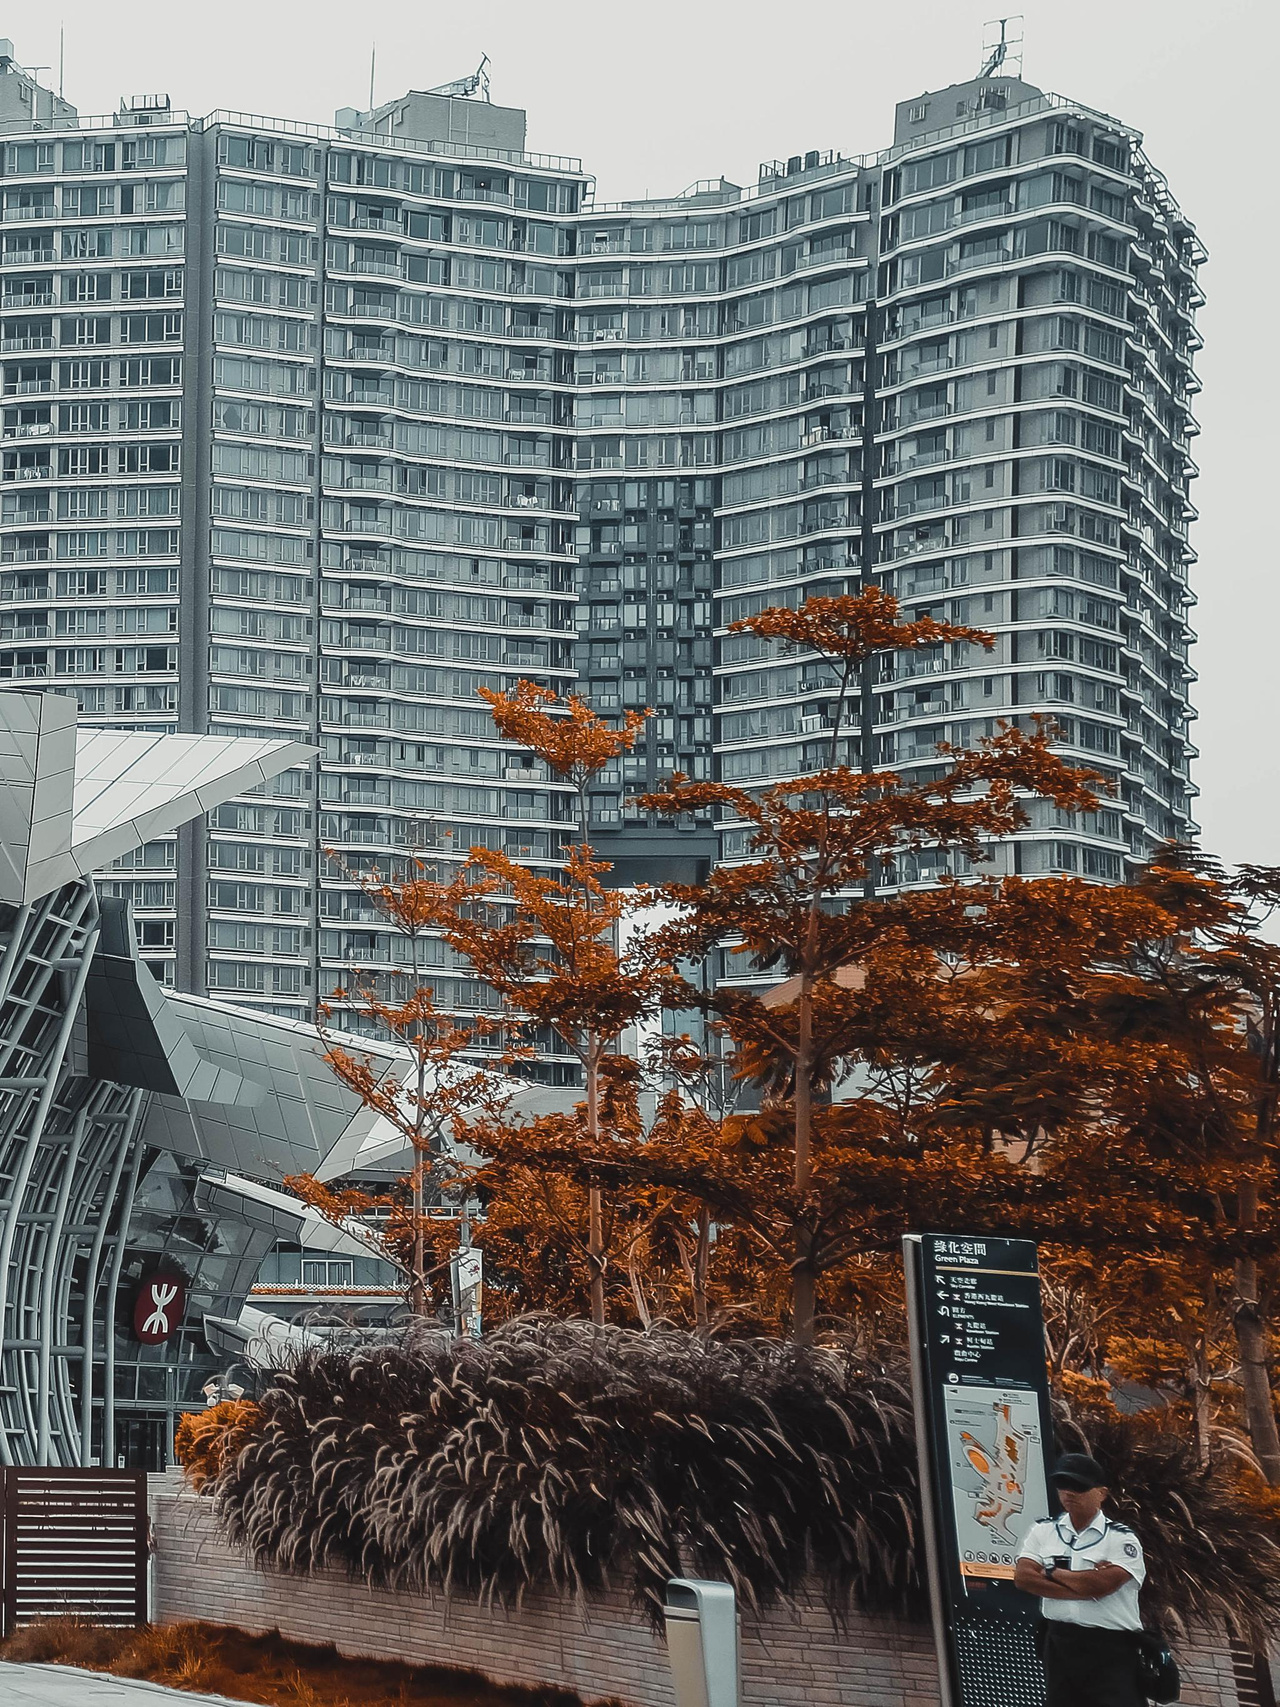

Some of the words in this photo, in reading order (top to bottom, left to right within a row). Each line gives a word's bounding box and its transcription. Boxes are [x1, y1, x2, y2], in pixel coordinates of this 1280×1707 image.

[933, 1240, 987, 1256] 綠化空間
[934, 1254, 958, 1263] Green
[959, 1256, 979, 1265] Plaza
